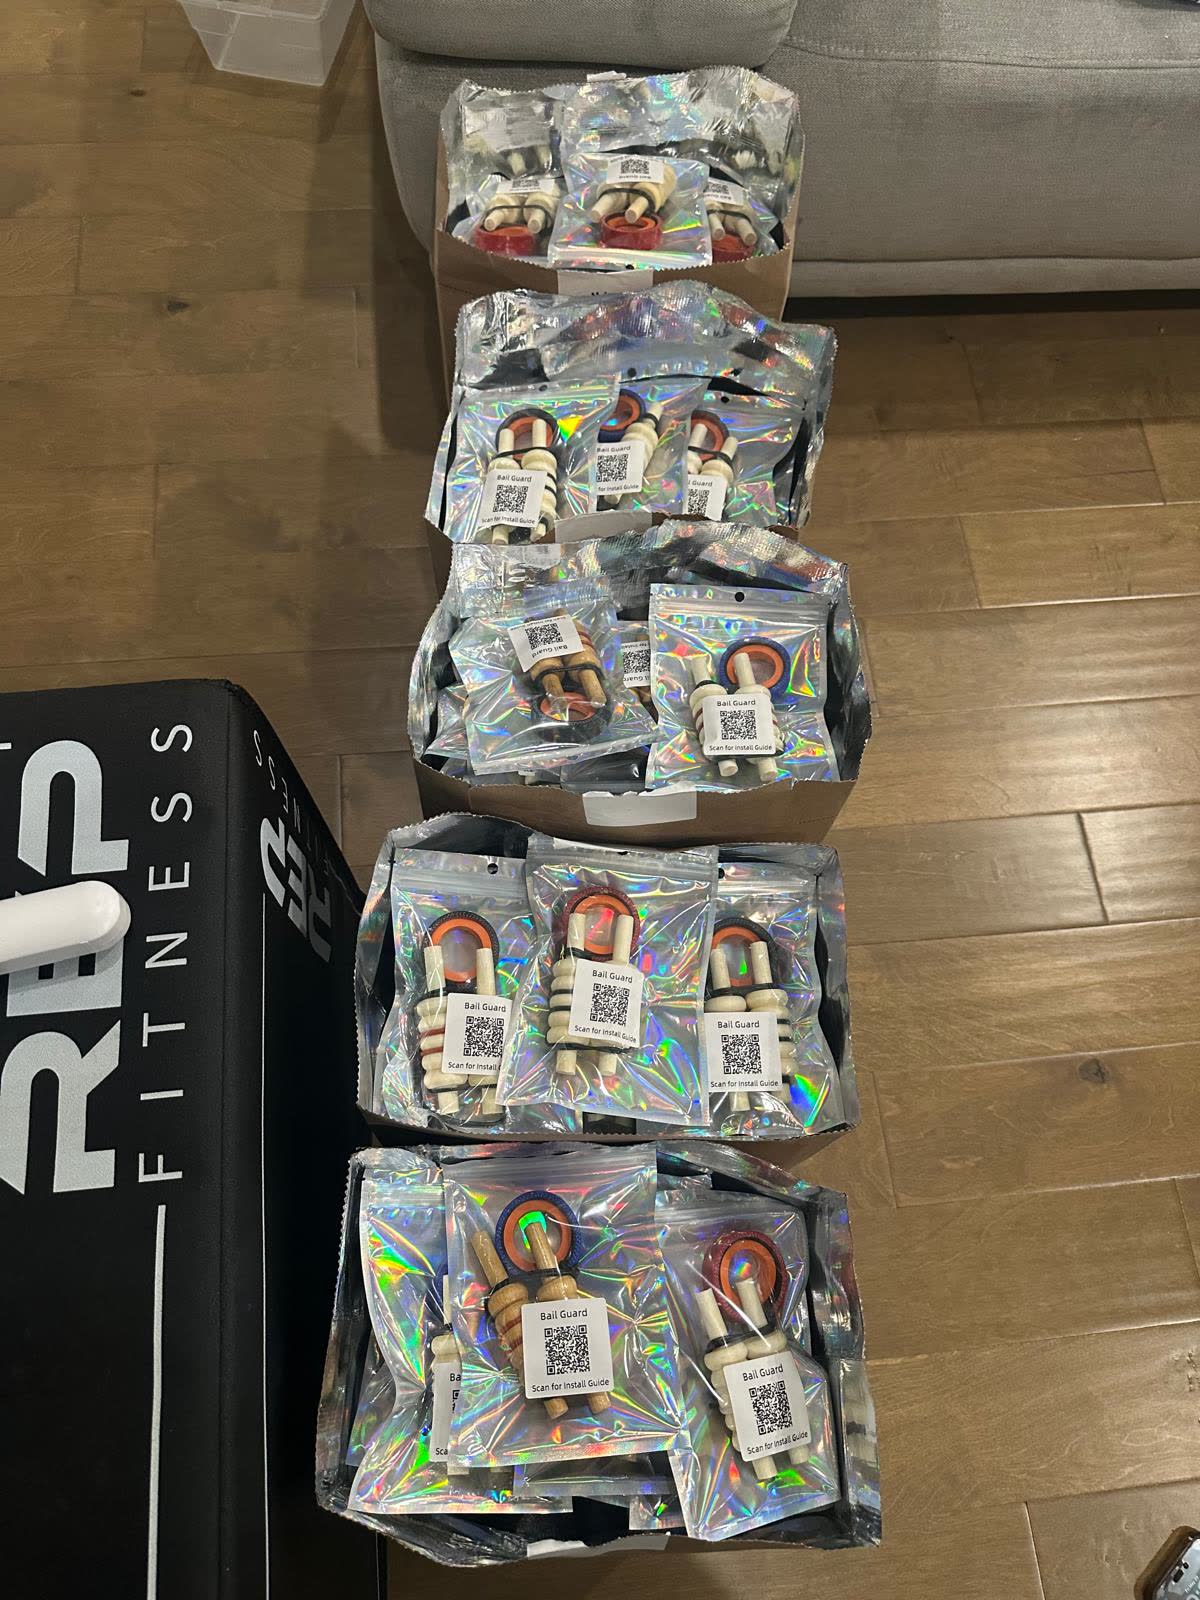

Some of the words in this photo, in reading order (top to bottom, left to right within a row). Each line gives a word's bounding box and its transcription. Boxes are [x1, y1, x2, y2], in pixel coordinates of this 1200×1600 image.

[531, 647, 553, 658] Guard
[138, 724, 193, 1183] FITNESS
[592, 969, 608, 979] Bail
[609, 972, 633, 983] Guard
[464, 1002, 480, 1010] Bail
[482, 1003, 506, 1012] Guard
[718, 1021, 733, 1029] Bail
[735, 1020, 760, 1028] Guard
[603, 1028, 620, 1037] Install
[621, 1033, 636, 1042] Guide
[448, 1061, 464, 1069] Scan
[477, 1062, 497, 1070] Install
[540, 1310, 557, 1320] Bail
[560, 1308, 588, 1318] Guard
[450, 1373, 461, 1382] Ba
[742, 1370, 759, 1381] Bail
[760, 1363, 784, 1377] Guard
[532, 1384, 550, 1392] Scan
[551, 1382, 562, 1391] for
[564, 1380, 587, 1389] Install
[588, 1378, 610, 1387] Guide
[747, 1444, 764, 1454] Scan
[764, 1441, 773, 1450] for
[774, 1435, 792, 1448] Install
[792, 1431, 808, 1442] Guide
[435, 1447, 448, 1455] Sca
